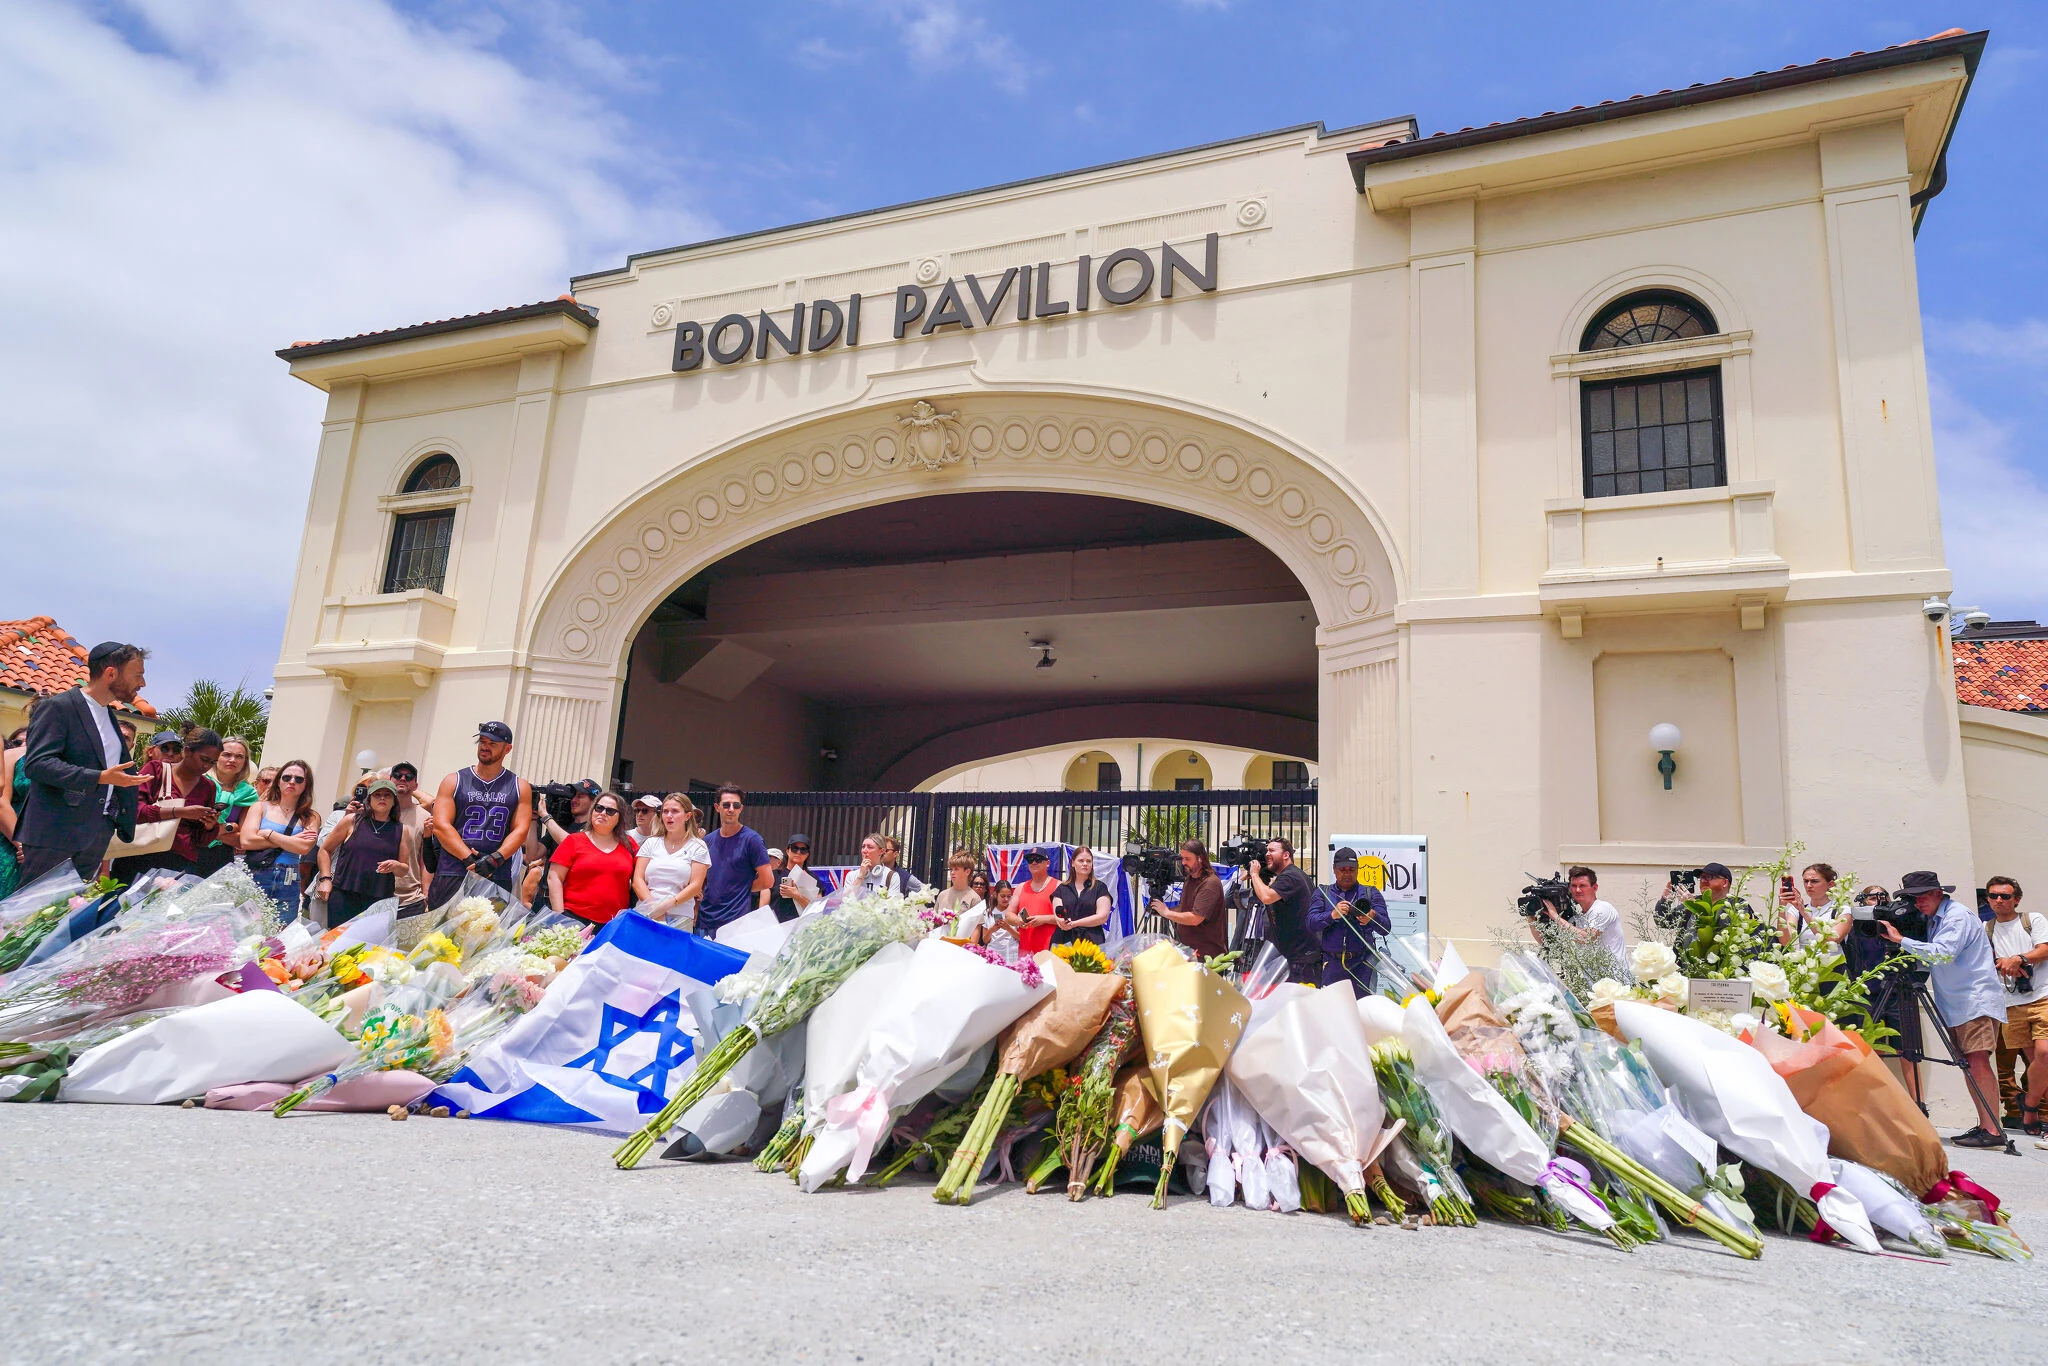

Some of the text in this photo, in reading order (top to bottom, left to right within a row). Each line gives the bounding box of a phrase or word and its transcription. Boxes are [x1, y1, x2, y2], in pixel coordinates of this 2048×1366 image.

[672, 232, 1219, 372] BONDI PAVILION
[467, 791, 507, 803] PSALM
[462, 804, 510, 842] 23
